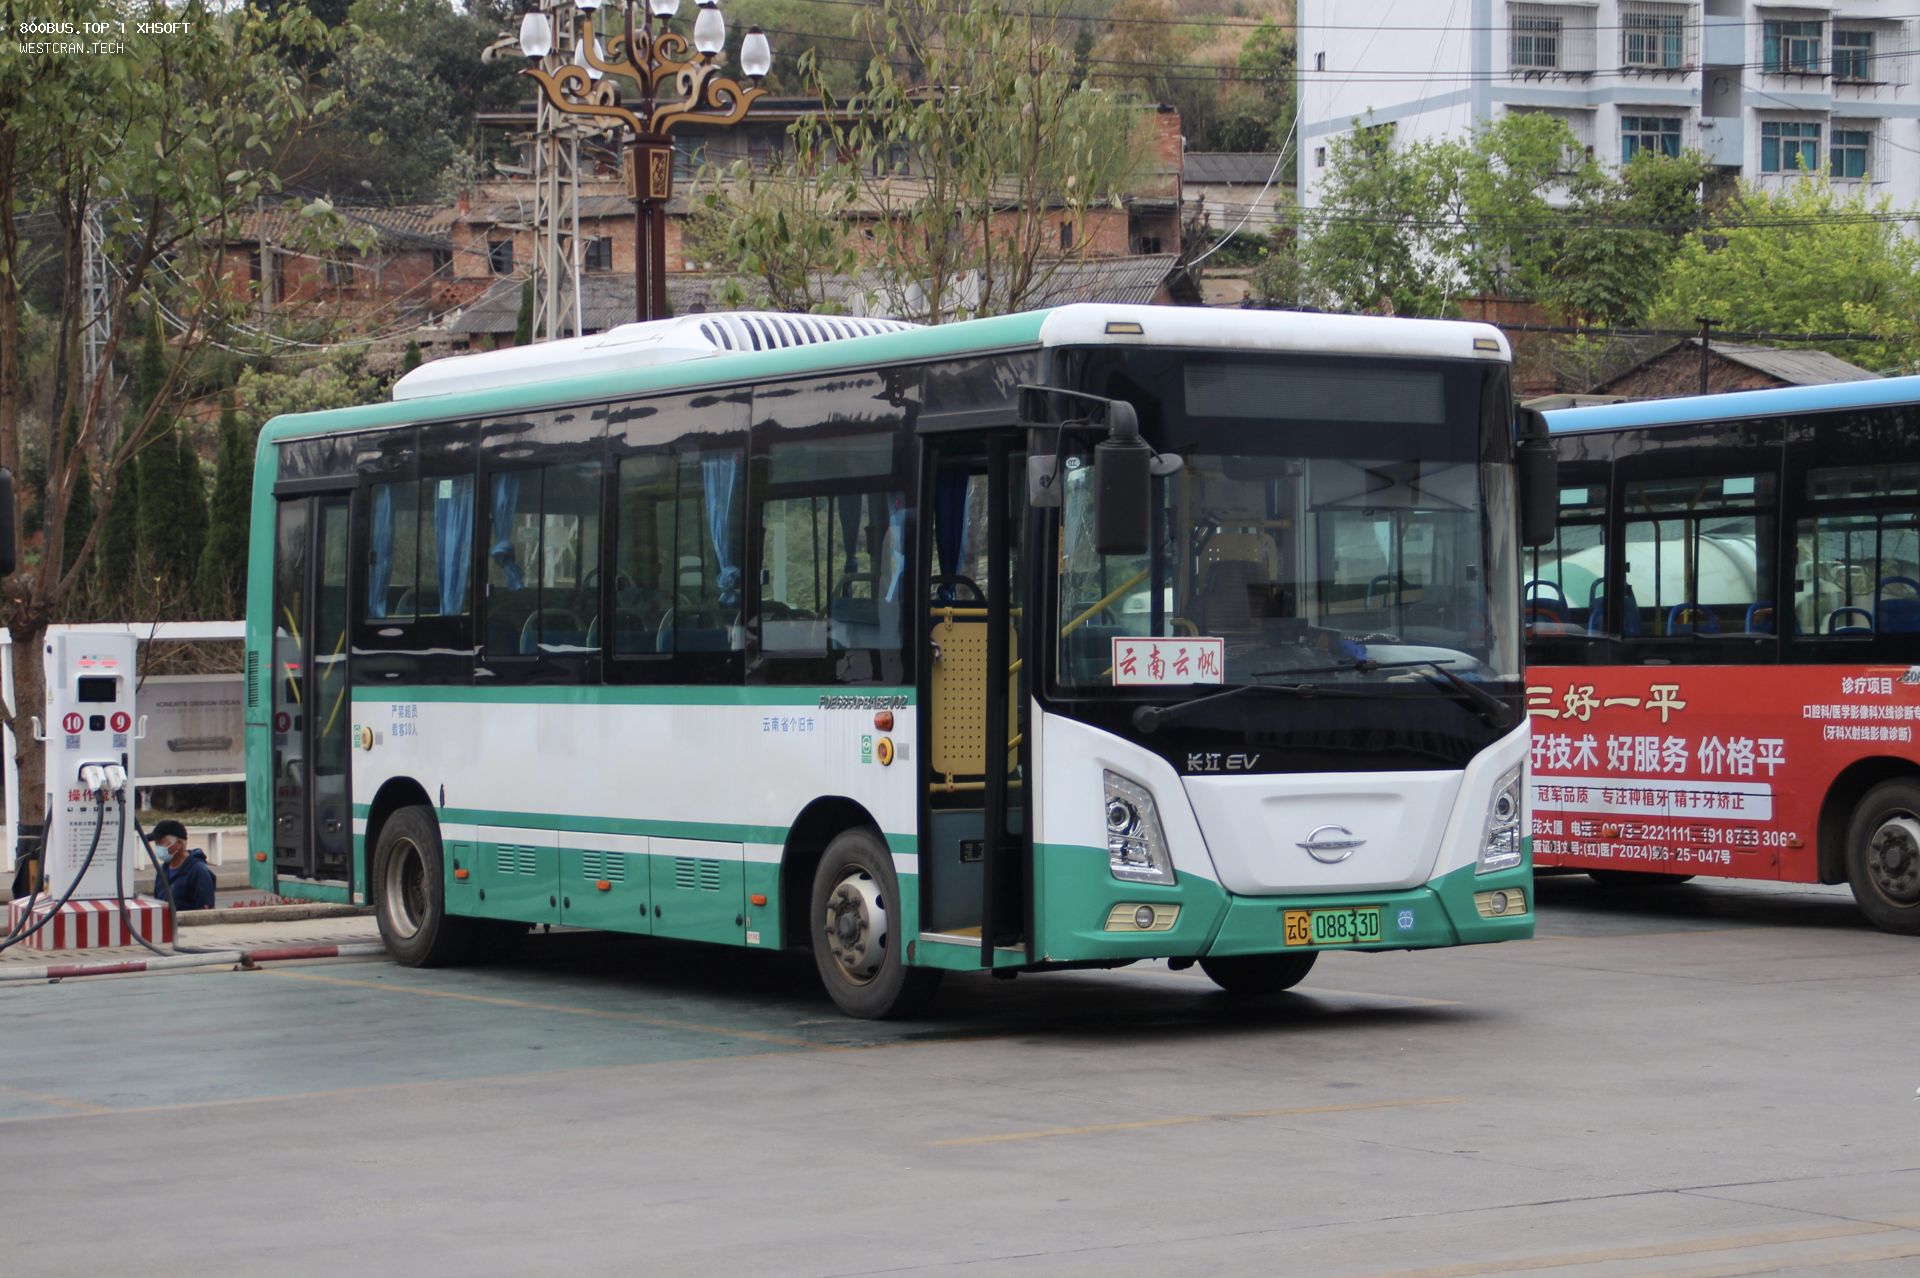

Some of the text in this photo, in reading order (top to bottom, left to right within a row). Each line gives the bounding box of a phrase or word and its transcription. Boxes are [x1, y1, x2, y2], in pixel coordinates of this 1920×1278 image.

[1120, 643, 1219, 680] 云南云帆
[1842, 676, 1892, 694] 诊疗项目
[1526, 683, 1687, 724] 三好一平
[66, 716, 82, 730] 10
[117, 715, 125, 729] 9
[762, 717, 815, 732] 云南省个旧市
[1187, 753, 1260, 771] 长江 EV
[1606, 734, 1689, 774] 好服务
[1697, 735, 1786, 777] 价格平
[1538, 785, 1589, 804] 冠军品质
[1602, 786, 1669, 807] 专注种植牙
[1287, 912, 1379, 940] 云G 08833D
